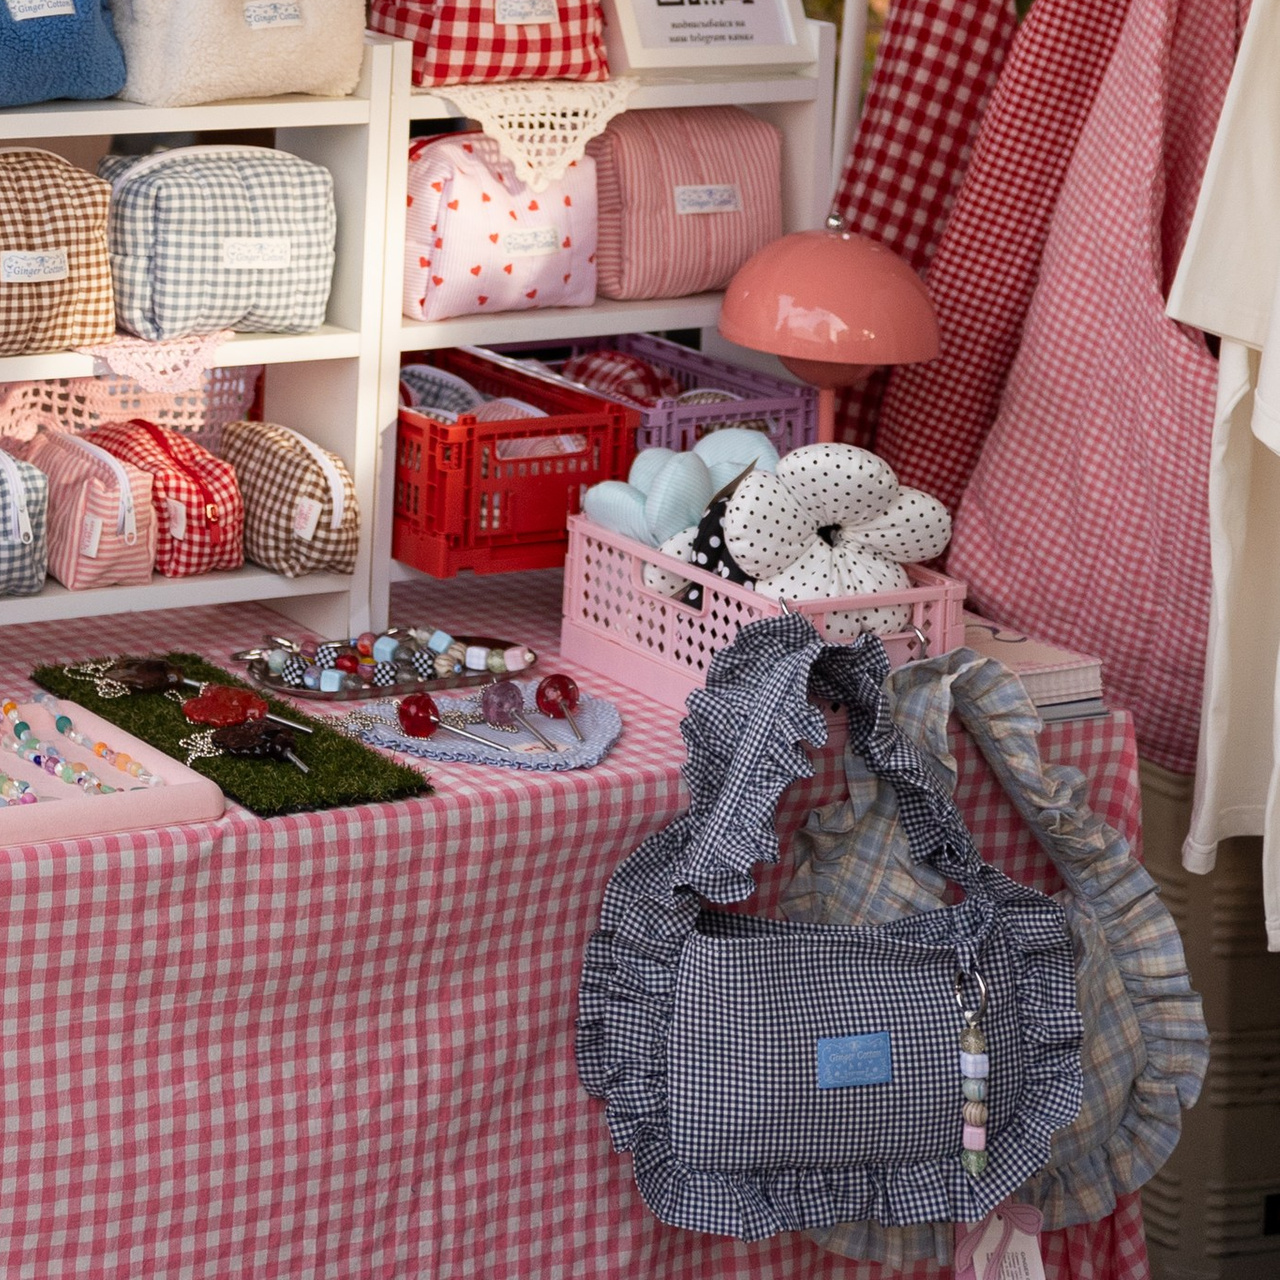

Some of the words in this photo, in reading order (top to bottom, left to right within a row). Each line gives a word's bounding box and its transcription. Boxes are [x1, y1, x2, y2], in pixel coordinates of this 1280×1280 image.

[18, 3, 45, 14] Ginger
[47, 0, 71, 9] Cotton
[13, 266, 41, 277] Ginger
[829, 1052, 855, 1064] Ginger
